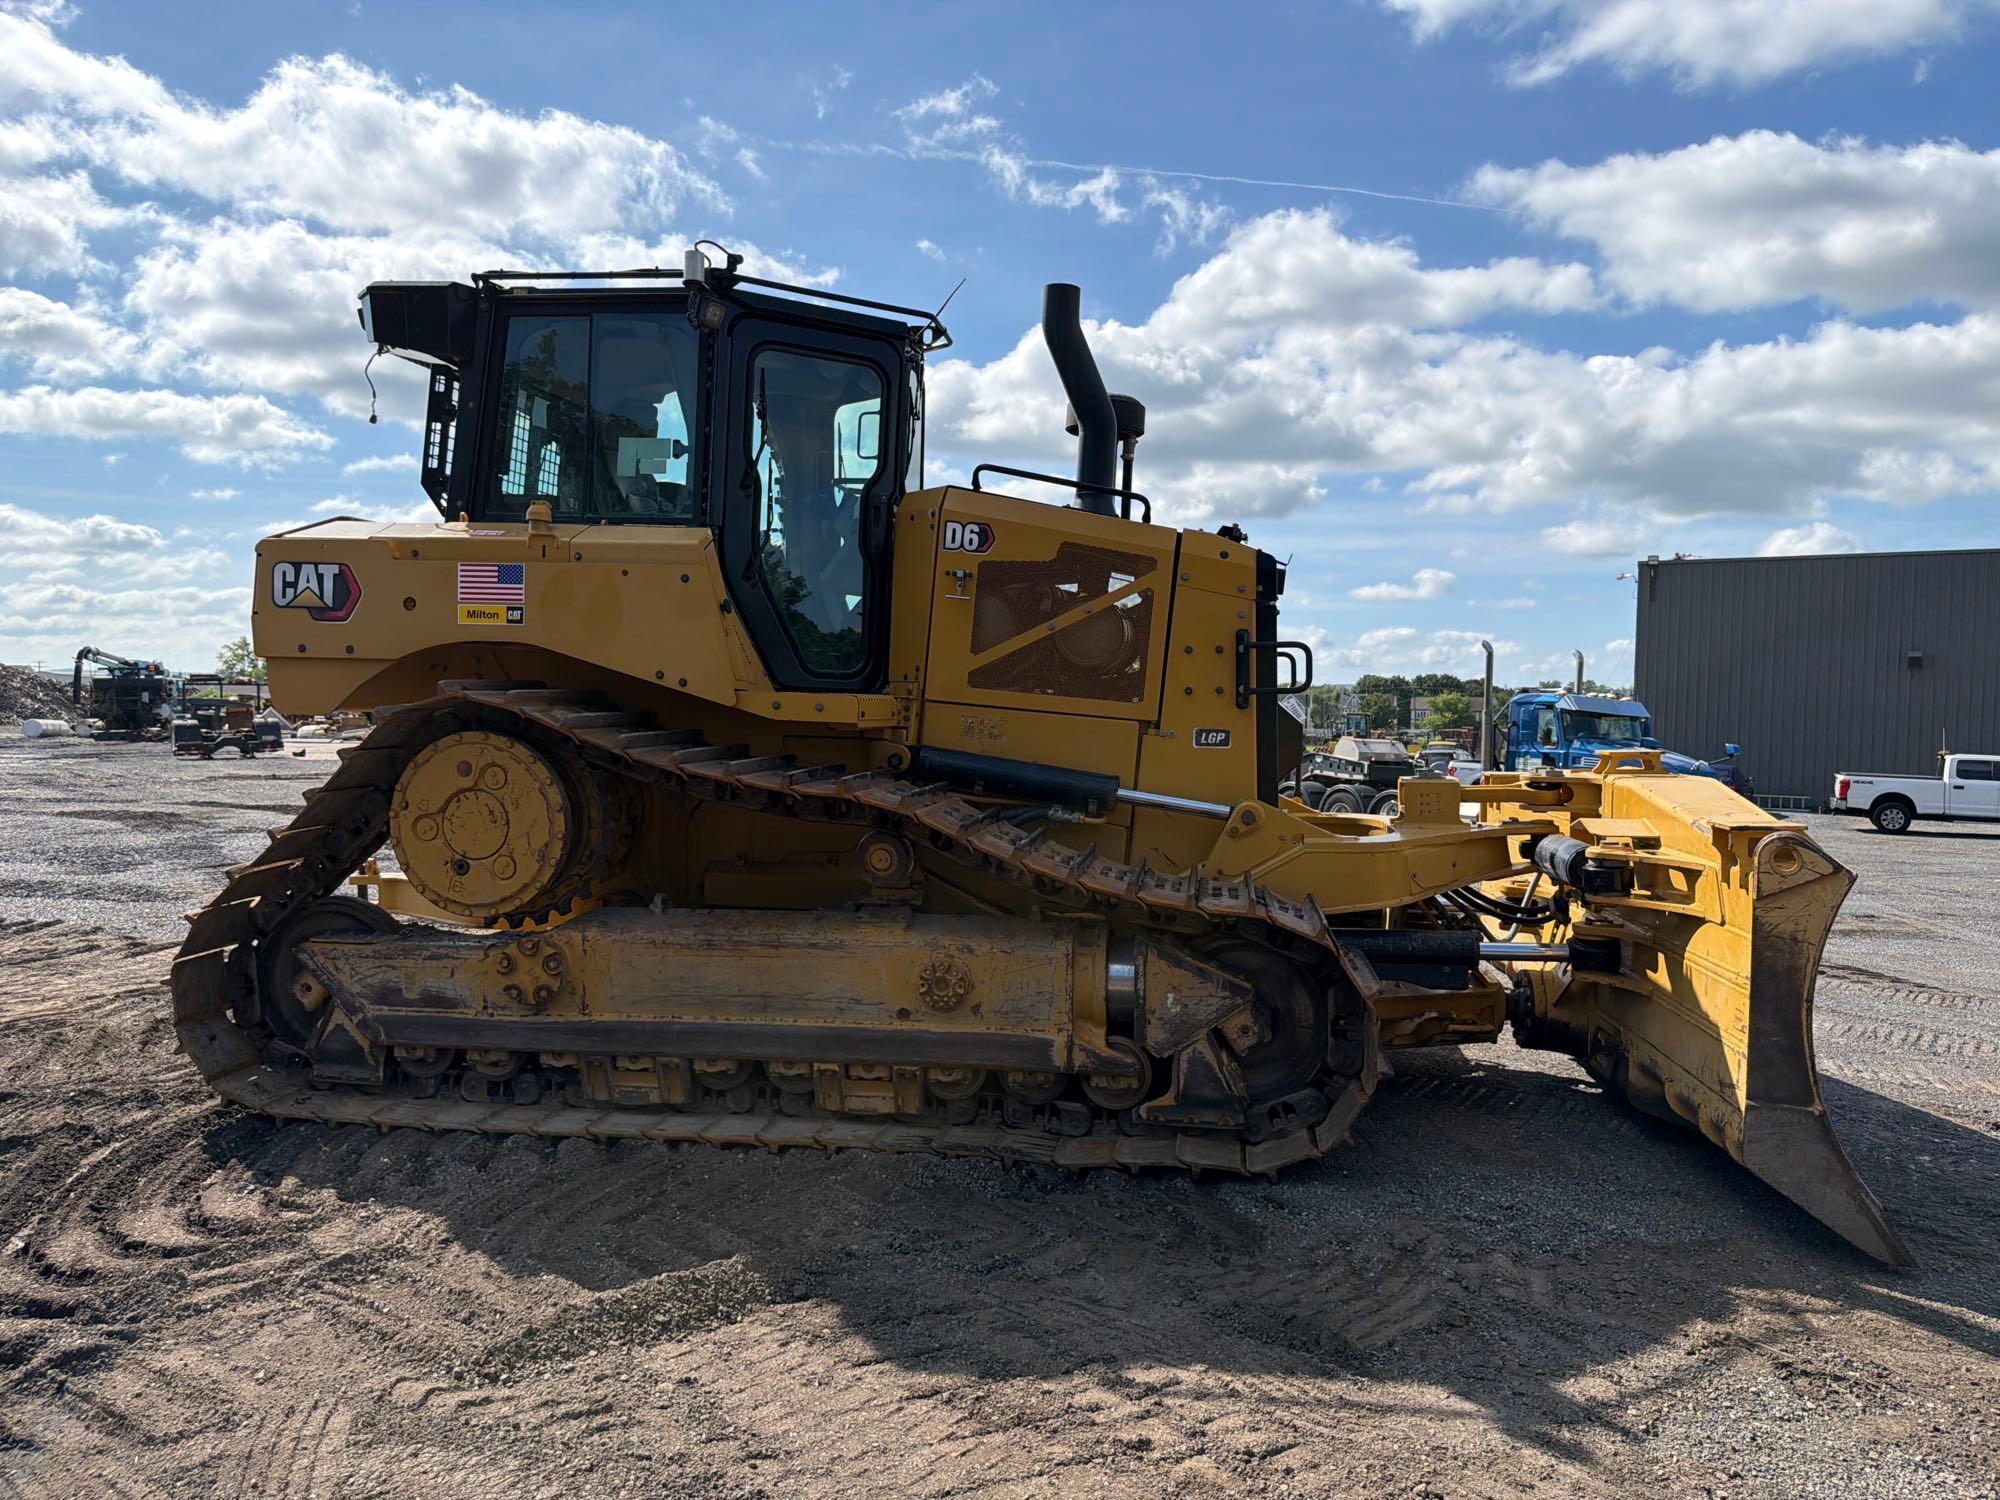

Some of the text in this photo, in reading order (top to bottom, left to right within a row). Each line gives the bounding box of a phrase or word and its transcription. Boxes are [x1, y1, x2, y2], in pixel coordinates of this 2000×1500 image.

[944, 521, 980, 551] D6
[273, 562, 339, 608] CAT
[466, 609, 522, 620] Milton CAT
[1200, 732, 1226, 744] LGP
